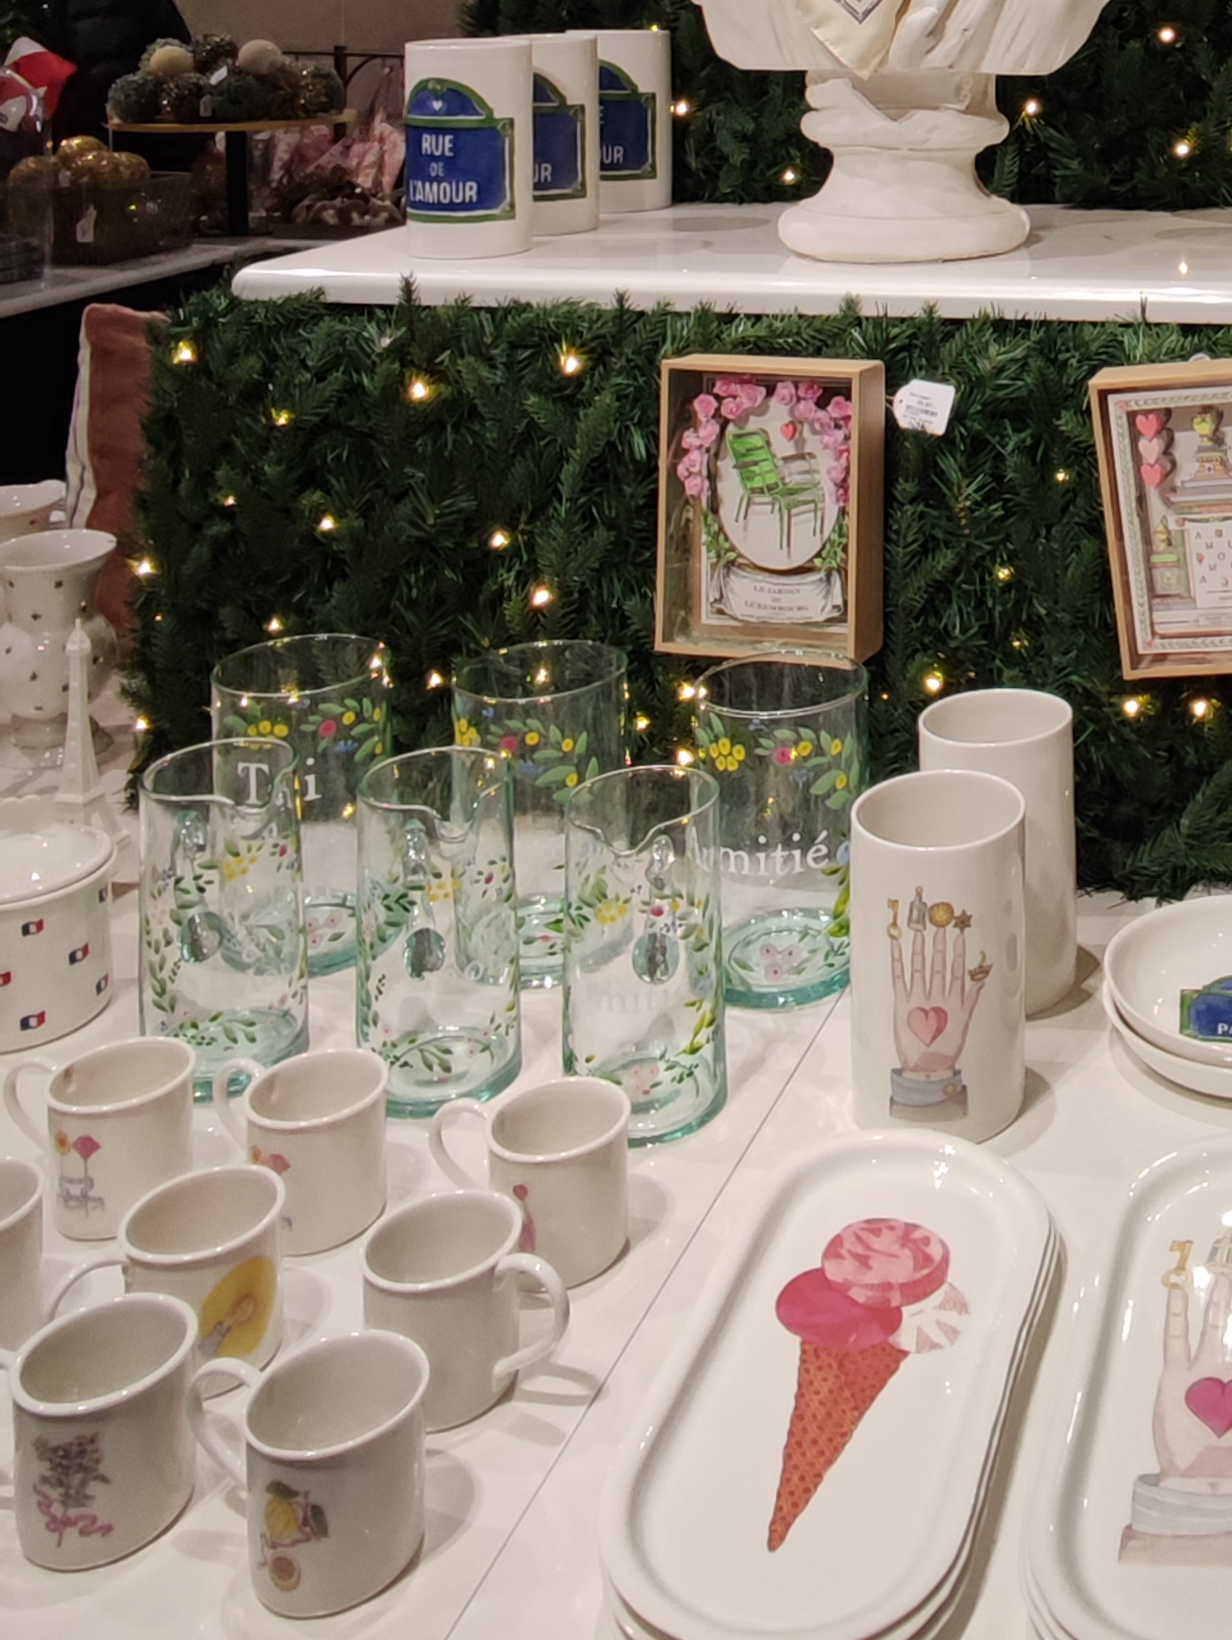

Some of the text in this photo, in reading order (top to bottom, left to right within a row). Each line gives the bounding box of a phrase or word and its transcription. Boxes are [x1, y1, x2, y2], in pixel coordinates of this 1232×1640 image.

[421, 133, 455, 157] RUE
[430, 162, 445, 178] DE
[408, 180, 478, 205] L'AMOUR
